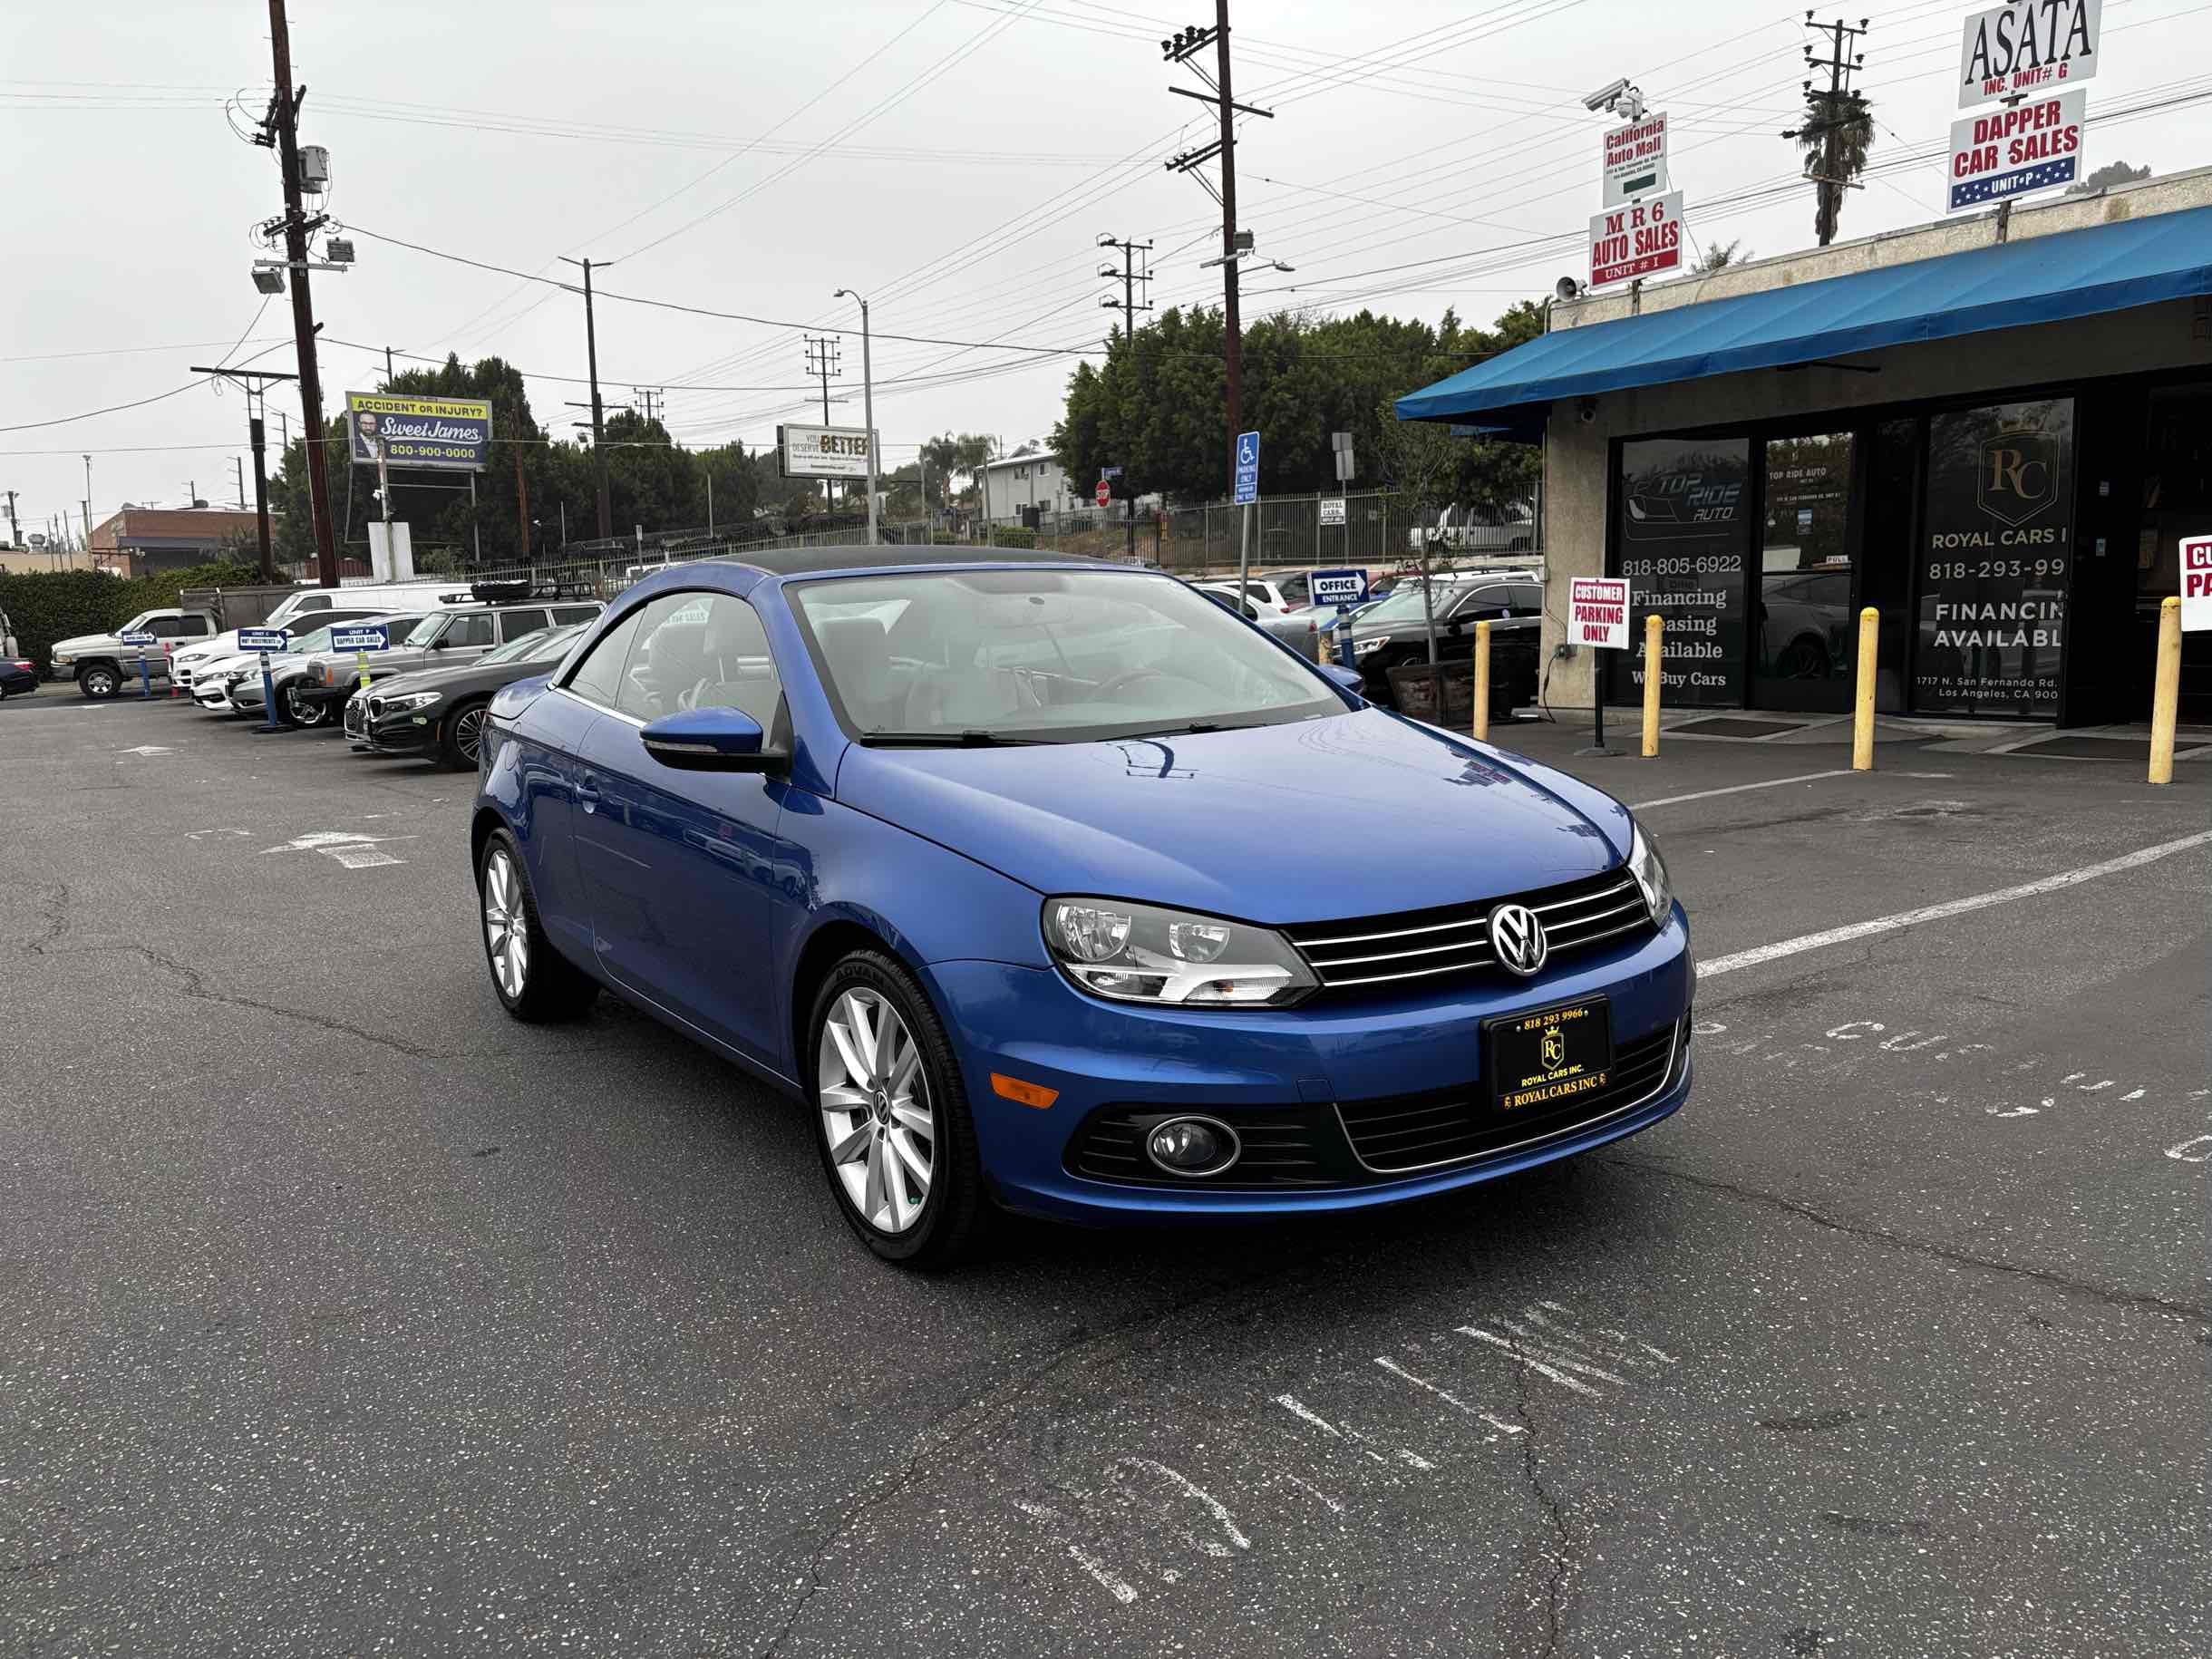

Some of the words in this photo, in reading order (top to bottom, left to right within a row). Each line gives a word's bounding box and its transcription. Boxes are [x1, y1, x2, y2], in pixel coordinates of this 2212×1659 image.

[1965, 0, 2092, 85] ASATA
[1984, 77, 2008, 95] INC.
[2058, 63, 2068, 79] G
[1974, 101, 2062, 145] DAPPER
[1606, 119, 1664, 150] California
[1606, 148, 1633, 168] Auto
[1635, 136, 1661, 158] Mall
[1954, 145, 1998, 177] CAR
[2008, 125, 2079, 165] SALES
[1652, 201, 1664, 222] 6
[1593, 235, 1629, 267] AUTO
[1635, 220, 1678, 256] SALES
[1605, 264, 1635, 279] UNIT
[1640, 260, 1648, 269] #
[357, 400, 416, 412] ACCIDENT
[420, 405, 433, 413] OR
[435, 406, 482, 417] INJURY?
[381, 417, 429, 435] Sweet
[428, 421, 479, 440] James
[391, 445, 475, 459] 800-900-0000
[1769, 471, 1783, 480] TOP
[1786, 469, 1803, 479] RIDE
[1806, 467, 1827, 477] AUTO
[1693, 506, 1734, 521] AUTO
[1932, 531, 1994, 548] ROYAL
[2001, 529, 2054, 545] CARS
[1622, 555, 1741, 577] 818-805-6922
[1929, 558, 2065, 579] 818-293-99
[1320, 580, 1357, 591] OFFICE
[1575, 584, 1624, 601] CUSTOMER
[1322, 593, 1358, 603] ENTRANCE
[1631, 588, 1727, 609] Financing
[1574, 605, 1624, 625] PARKING
[1644, 615, 1717, 635] asing
[1583, 625, 1610, 643] ONLY
[1635, 641, 1723, 658] Aailable
[1660, 671, 1686, 688] Buy
[1691, 672, 1726, 686] Cars
[1916, 676, 1938, 686] 1717
[1942, 677, 1953, 685] N.
[1956, 677, 1976, 686] San
[1980, 677, 2034, 687] Fernando
[1938, 688, 1957, 697] Los
[1961, 689, 2010, 699] Angeles,
[2013, 690, 2030, 698] CA
[2034, 690, 2058, 699] 900
[1524, 1017, 1541, 1031] 818
[1543, 1014, 1559, 1026] 293
[1562, 1008, 1583, 1022] 9966
[1544, 1040, 1561, 1060] RC
[1521, 1074, 1547, 1088] ROYAL
[1547, 1068, 1568, 1080] CARS
[1569, 1064, 1585, 1075] INC.
[1514, 1089, 1549, 1107] ROYAL
[1549, 1082, 1577, 1097] CARS
[1578, 1076, 1597, 1090] INC
